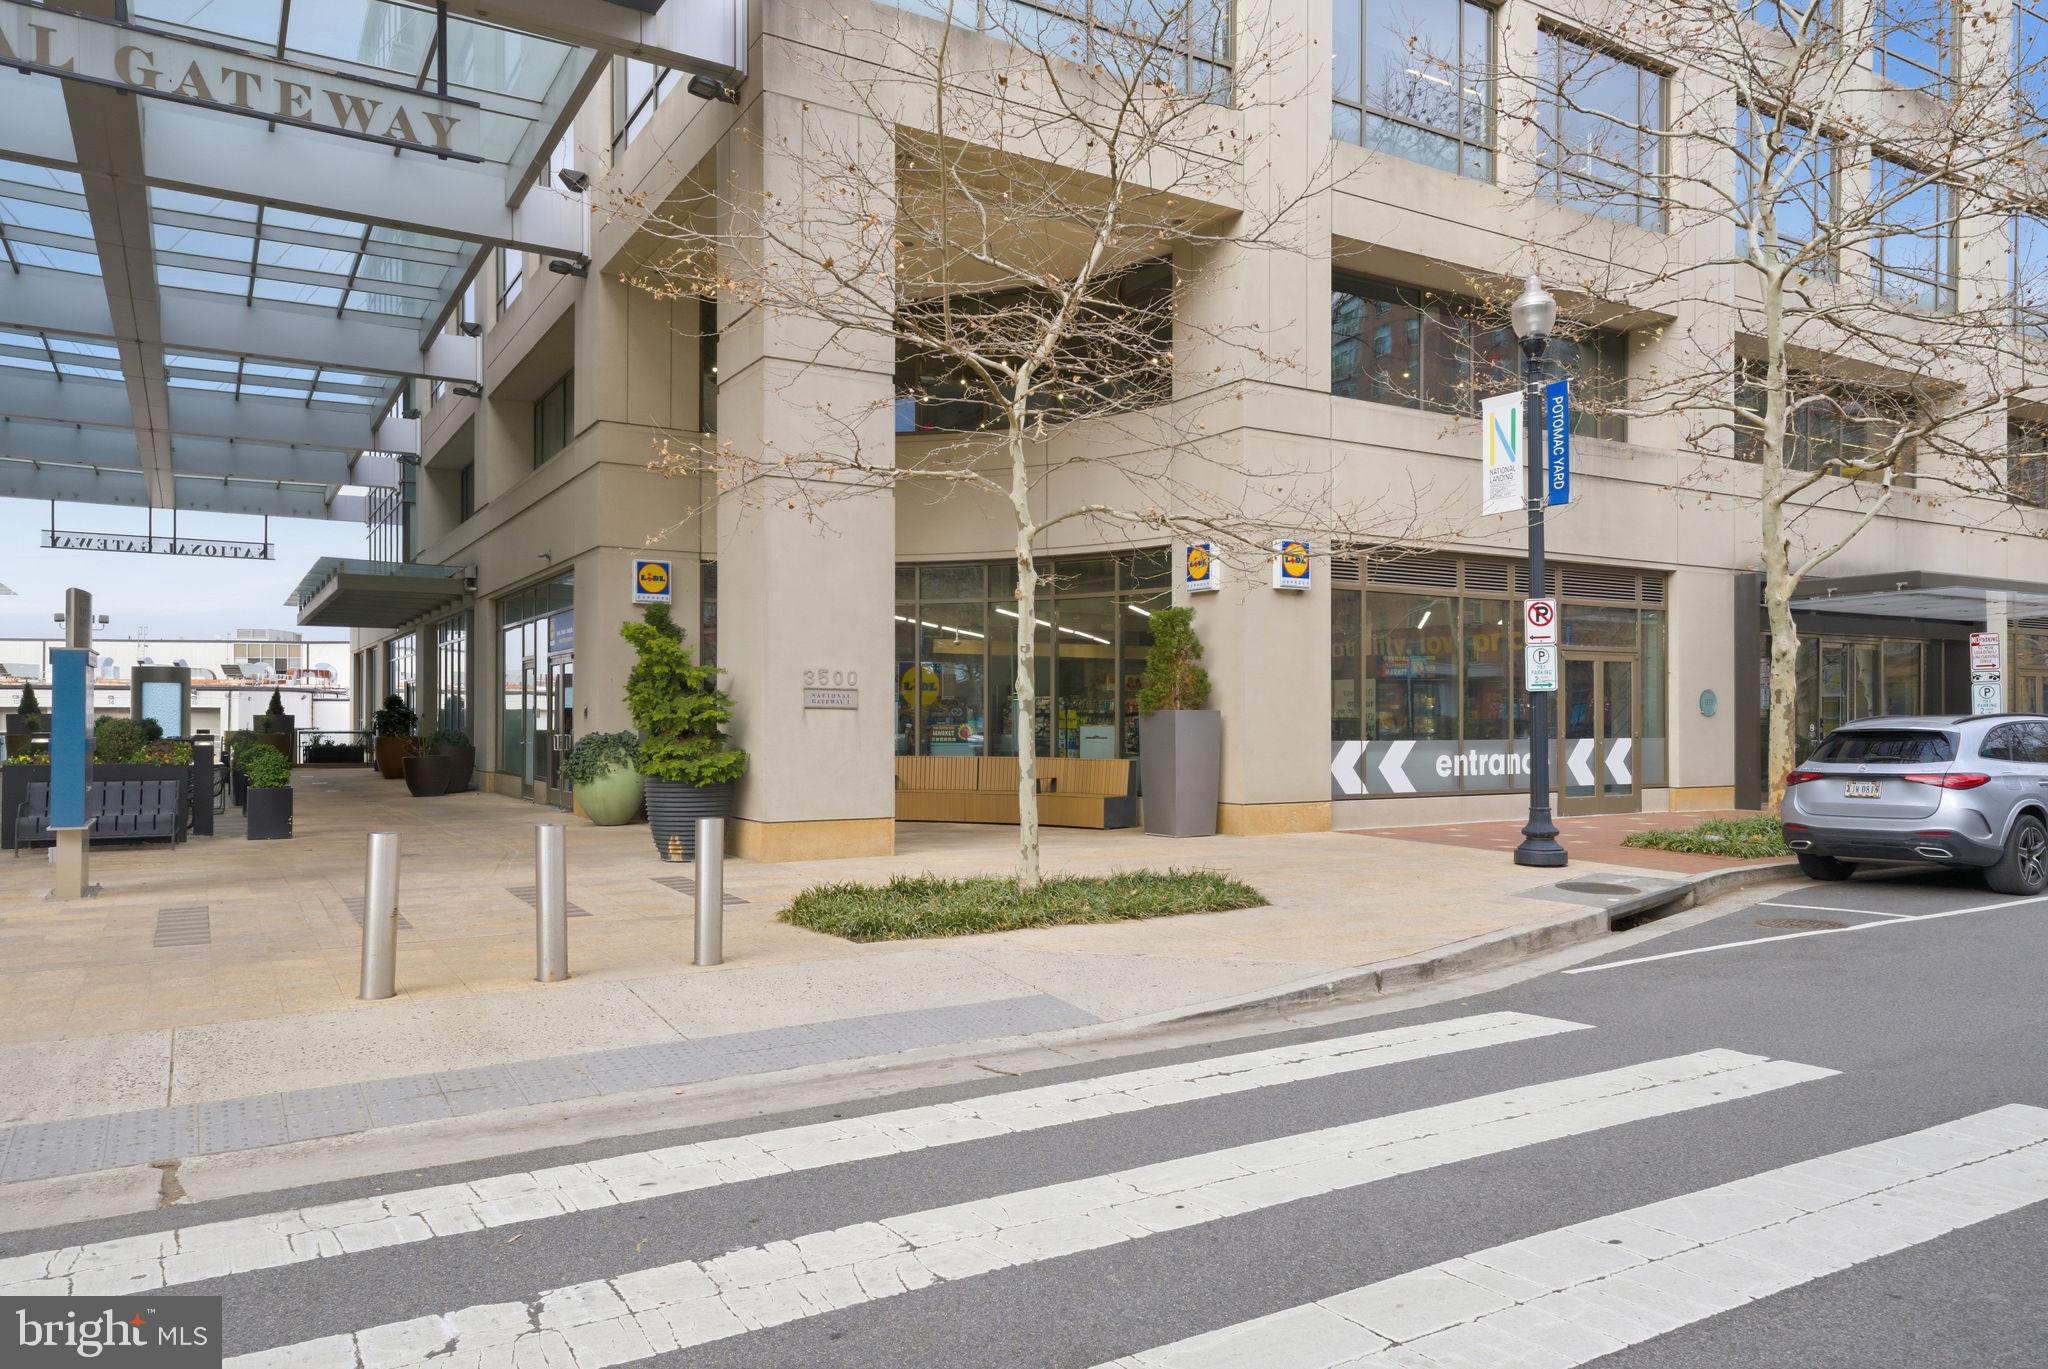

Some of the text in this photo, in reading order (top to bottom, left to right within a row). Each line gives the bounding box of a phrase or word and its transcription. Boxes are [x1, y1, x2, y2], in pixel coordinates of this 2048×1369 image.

[114, 45, 462, 151] GATEWAY
[1552, 396, 1565, 490] POTOMAC YARD
[1489, 465, 1516, 476] NATIONAL
[1489, 473, 1513, 484] LANDING
[803, 669, 858, 687] 3500
